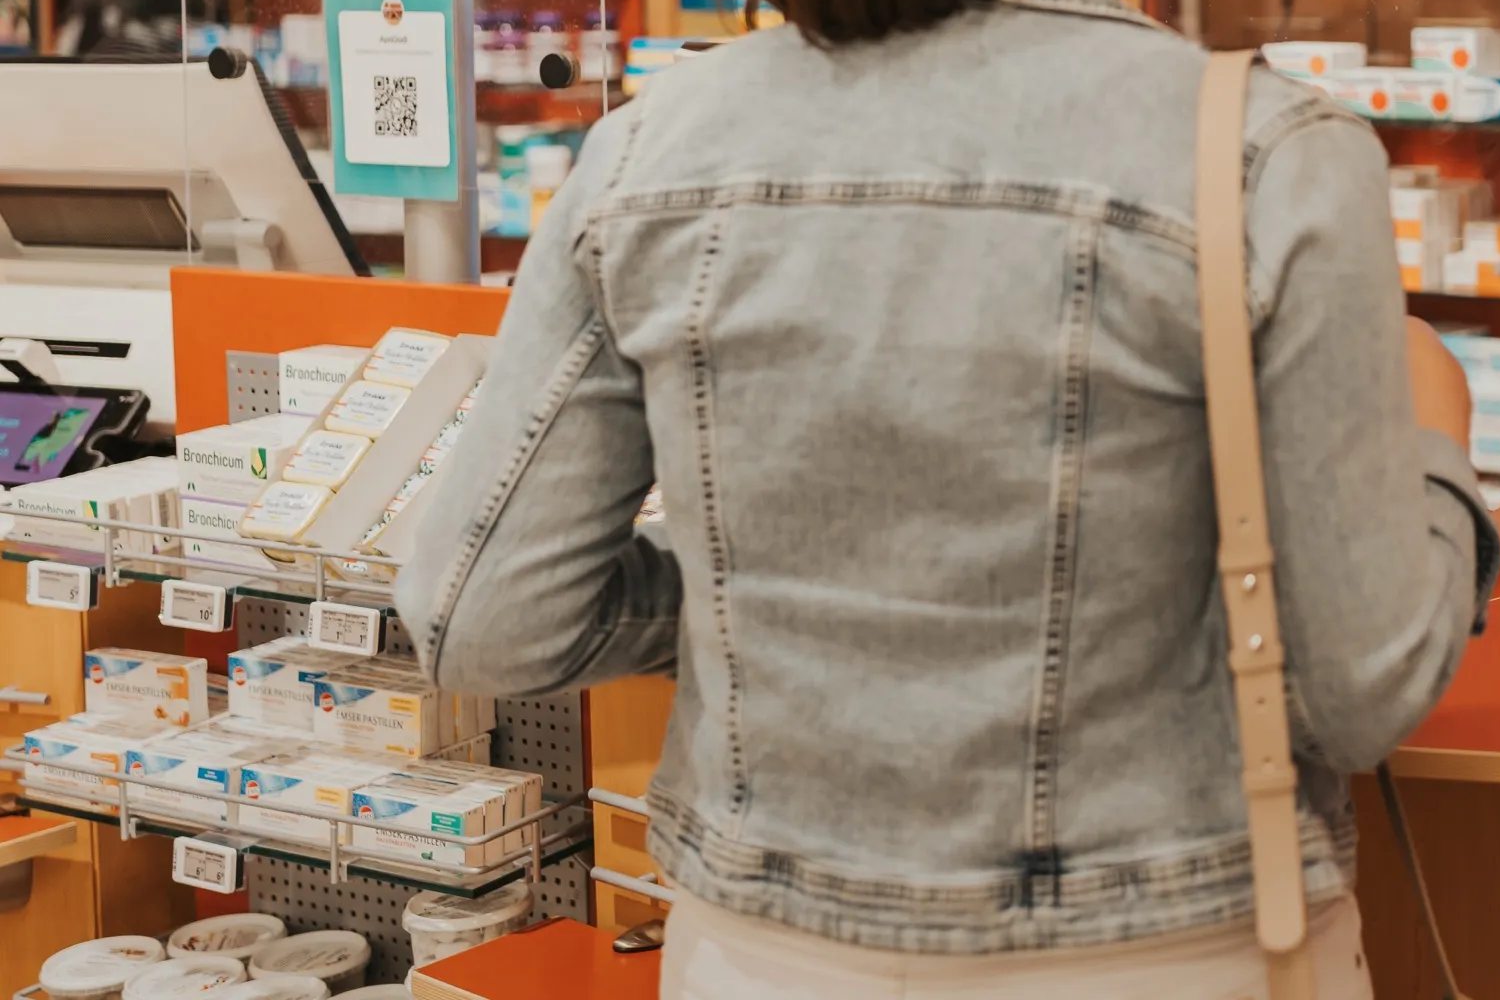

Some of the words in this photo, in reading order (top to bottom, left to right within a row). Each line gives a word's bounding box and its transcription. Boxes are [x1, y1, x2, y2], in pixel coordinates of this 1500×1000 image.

[285, 364, 347, 384] Bronchicum
[183, 447, 244, 470] Bronchicum
[188, 508, 238, 531] Bronchicu
[132, 686, 173, 699] PASTILLEN
[274, 689, 312, 703] PASTILLEN
[335, 711, 362, 723] EMSER
[362, 714, 404, 730] PASTILLEN
